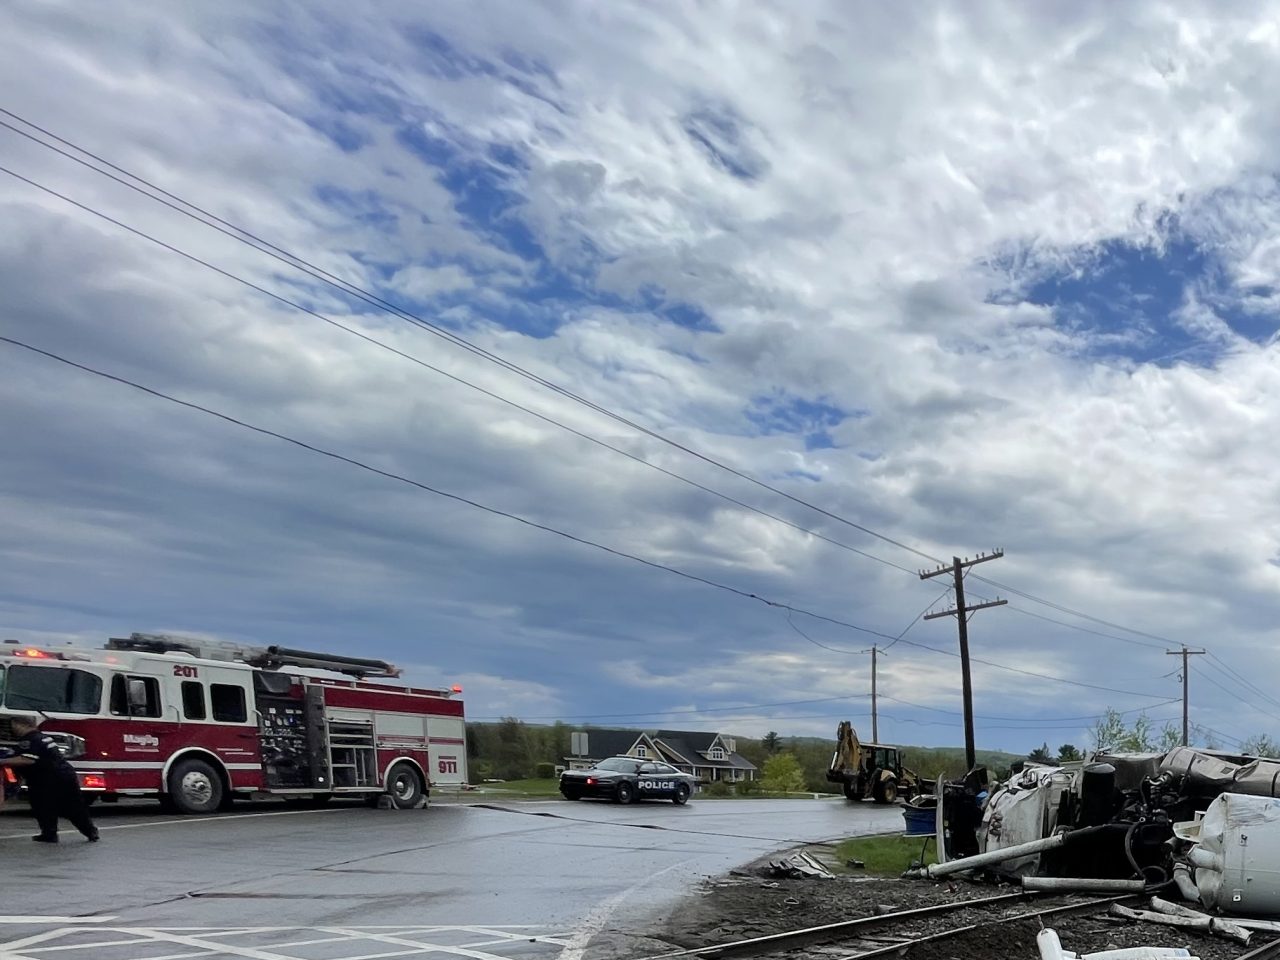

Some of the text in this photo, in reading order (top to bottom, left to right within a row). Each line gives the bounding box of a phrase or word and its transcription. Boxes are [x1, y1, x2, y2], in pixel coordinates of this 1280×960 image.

[173, 665, 198, 677] 201
[438, 761, 457, 774] 911
[638, 781, 675, 789] POLICE
